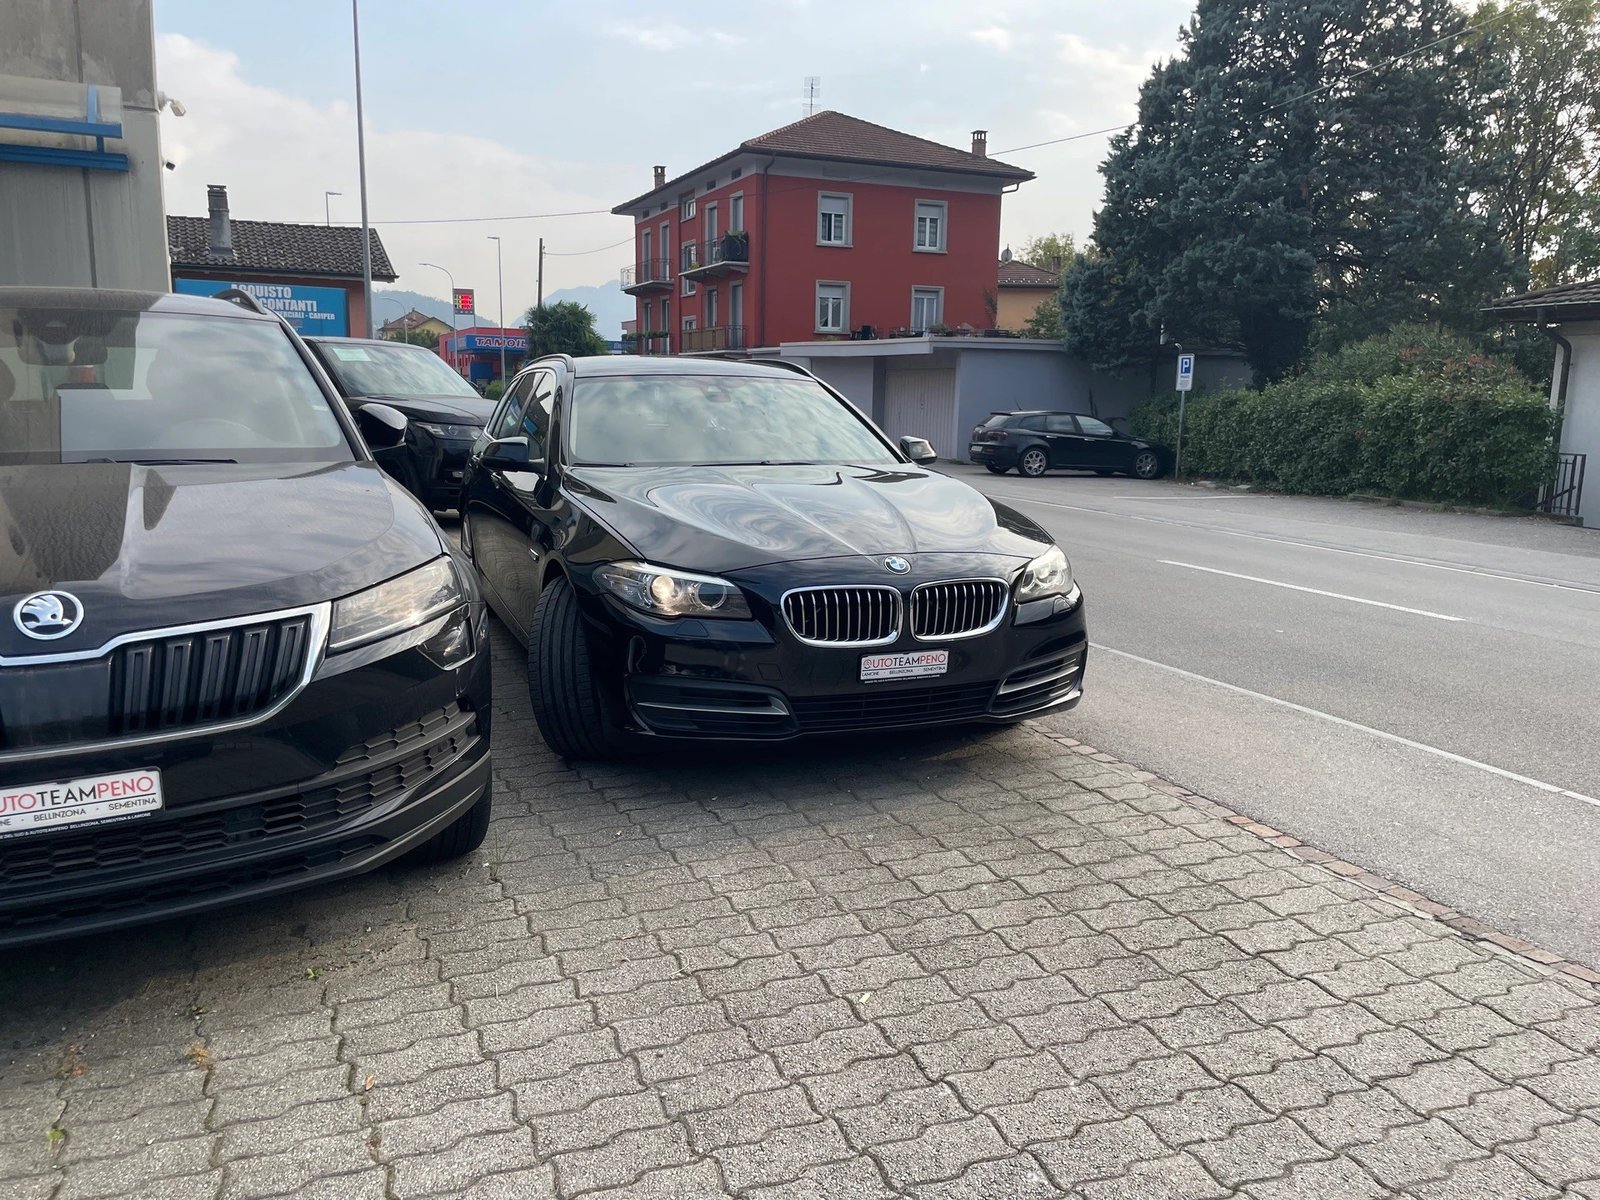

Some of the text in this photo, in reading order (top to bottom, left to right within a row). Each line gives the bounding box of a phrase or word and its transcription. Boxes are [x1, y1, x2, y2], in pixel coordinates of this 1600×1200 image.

[260, 297, 317, 311] CONTANTI
[475, 336, 528, 348] TAMOIL
[34, 808, 86, 822] BELLINZONA
[108, 797, 157, 811] SEMENTINA
